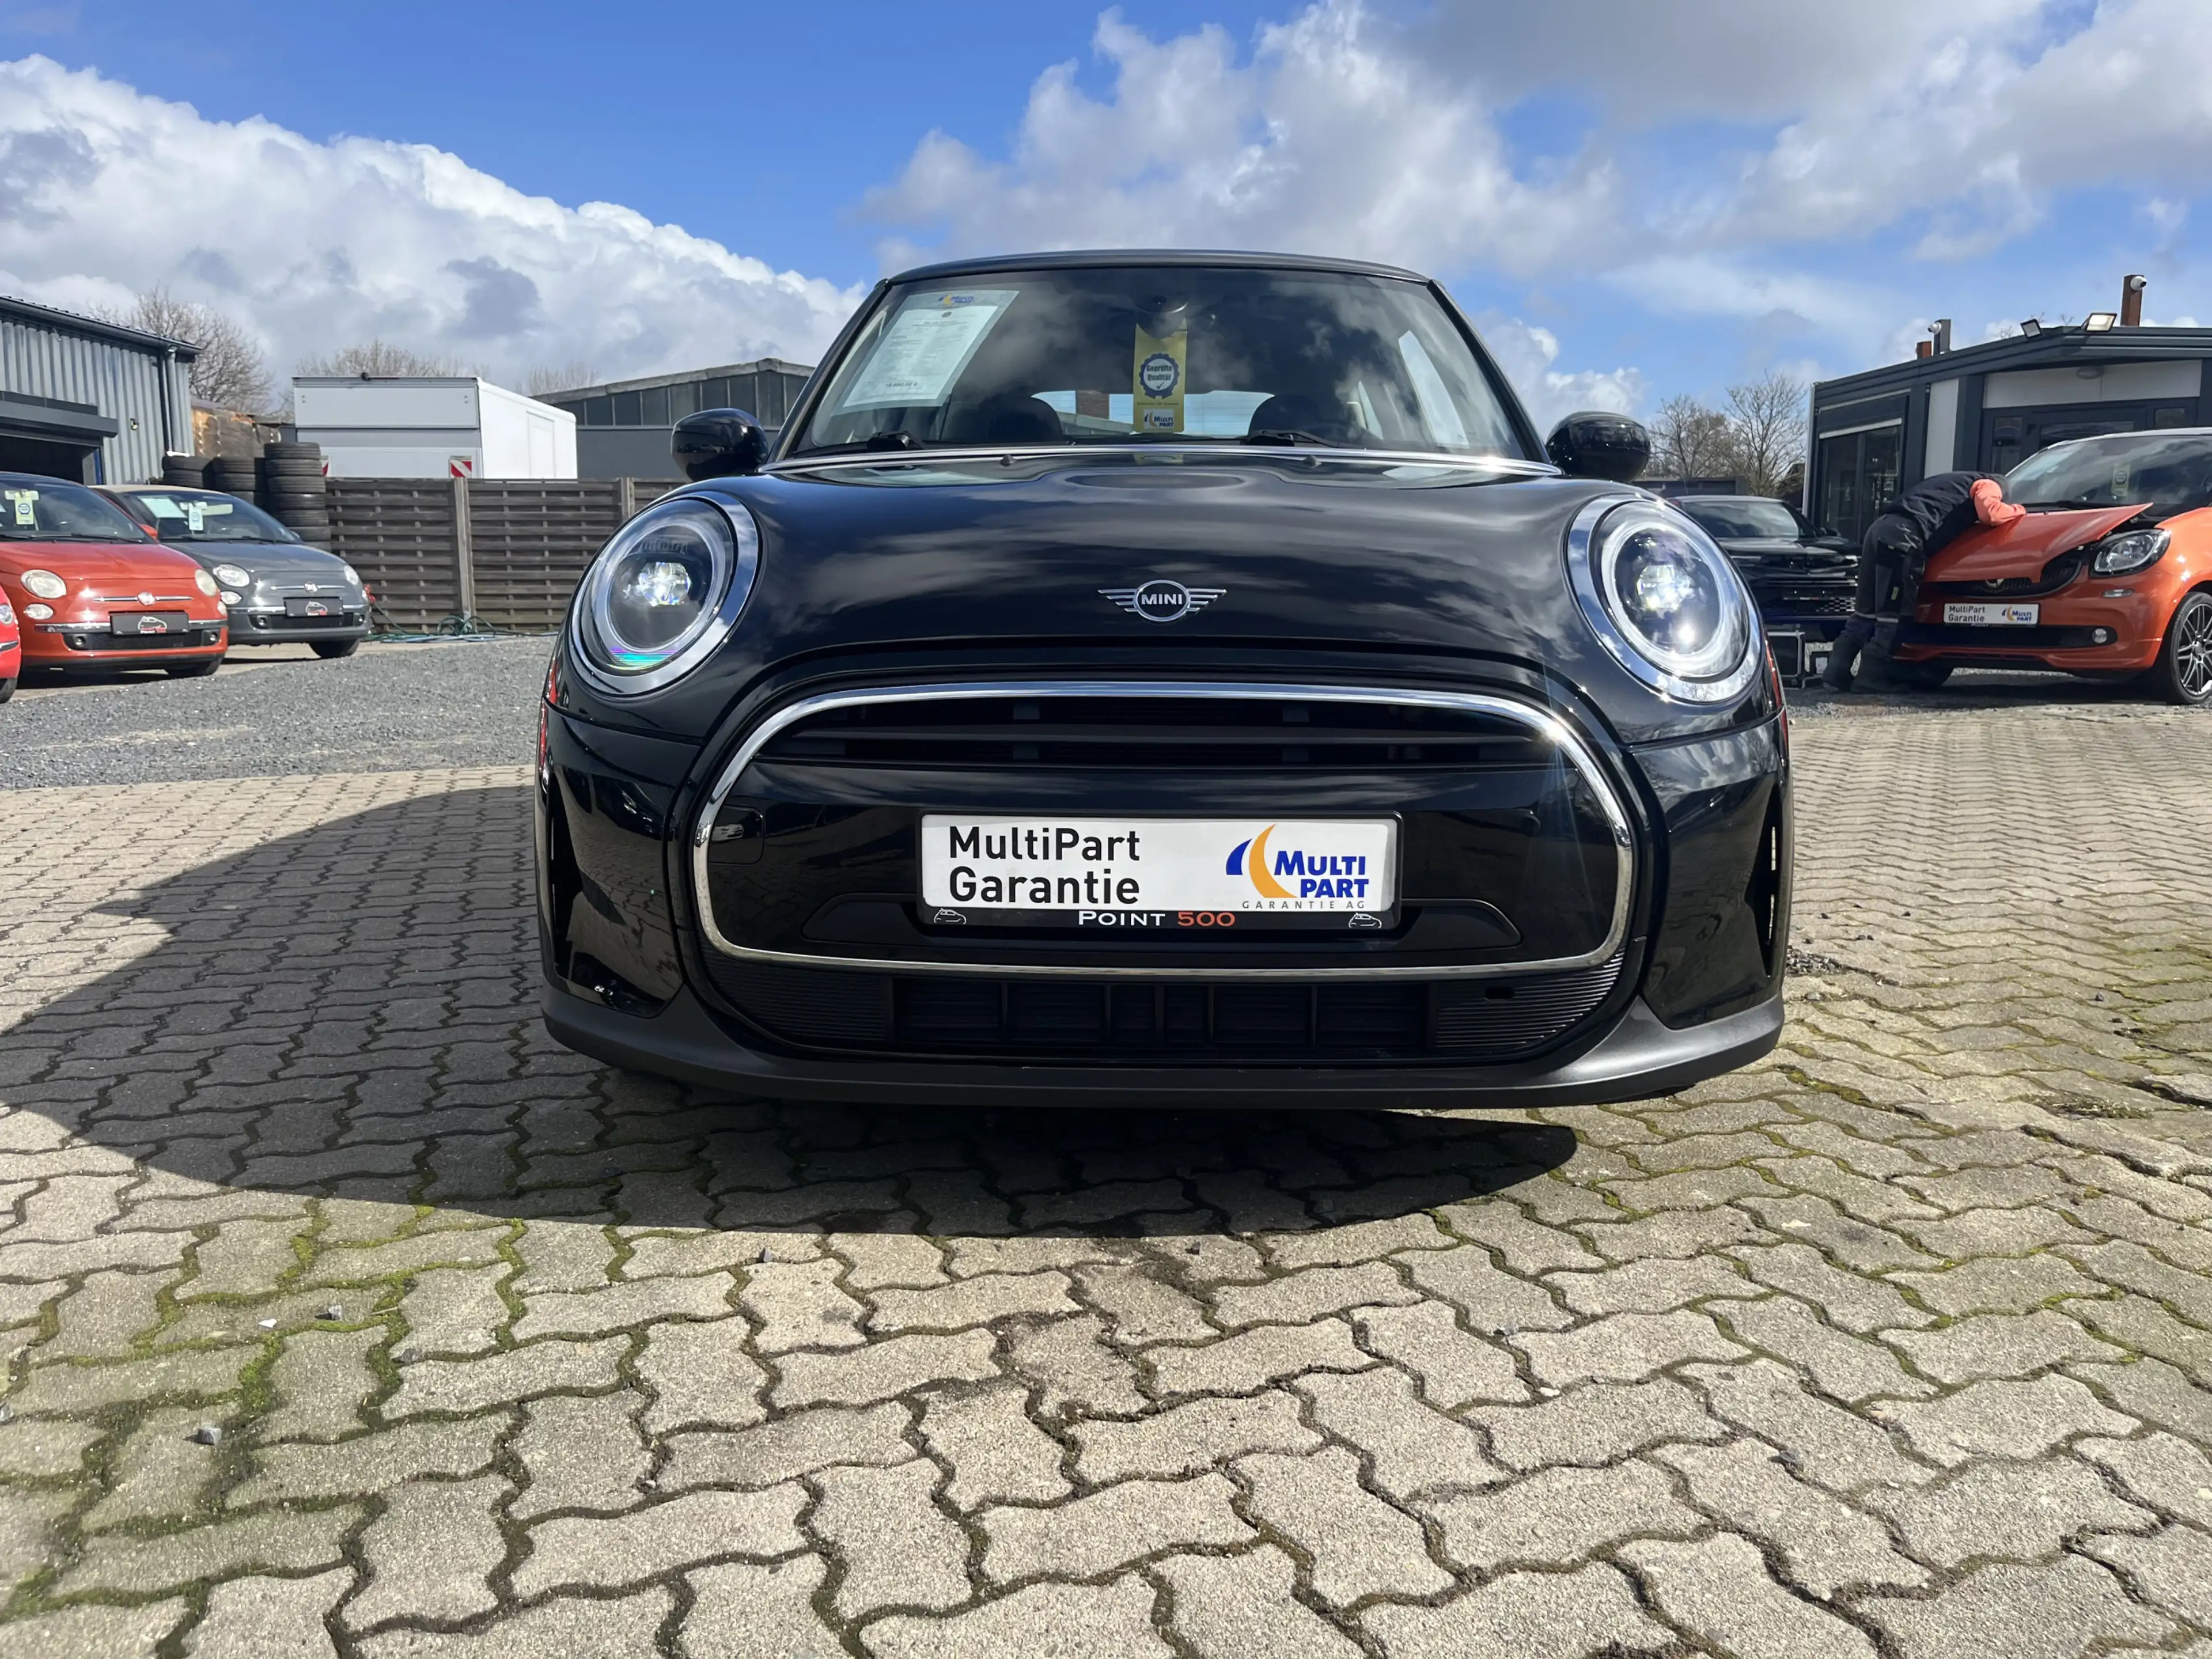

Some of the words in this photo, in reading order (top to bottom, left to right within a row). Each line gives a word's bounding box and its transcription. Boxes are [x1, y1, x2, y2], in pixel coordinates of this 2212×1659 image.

[1141, 593, 1183, 605] MINI
[1948, 613, 1985, 622] Garantie
[1949, 605, 1986, 613] MultiPart
[949, 825, 1140, 861] MultiPart
[1273, 850, 1366, 876] MULTI
[949, 865, 1140, 904] Garantie
[1300, 878, 1369, 898] PART
[1242, 900, 1335, 910] GARANTIE
[1346, 900, 1365, 910] AG
[1078, 910, 1166, 927] POINT
[1177, 911, 1236, 927] 500
